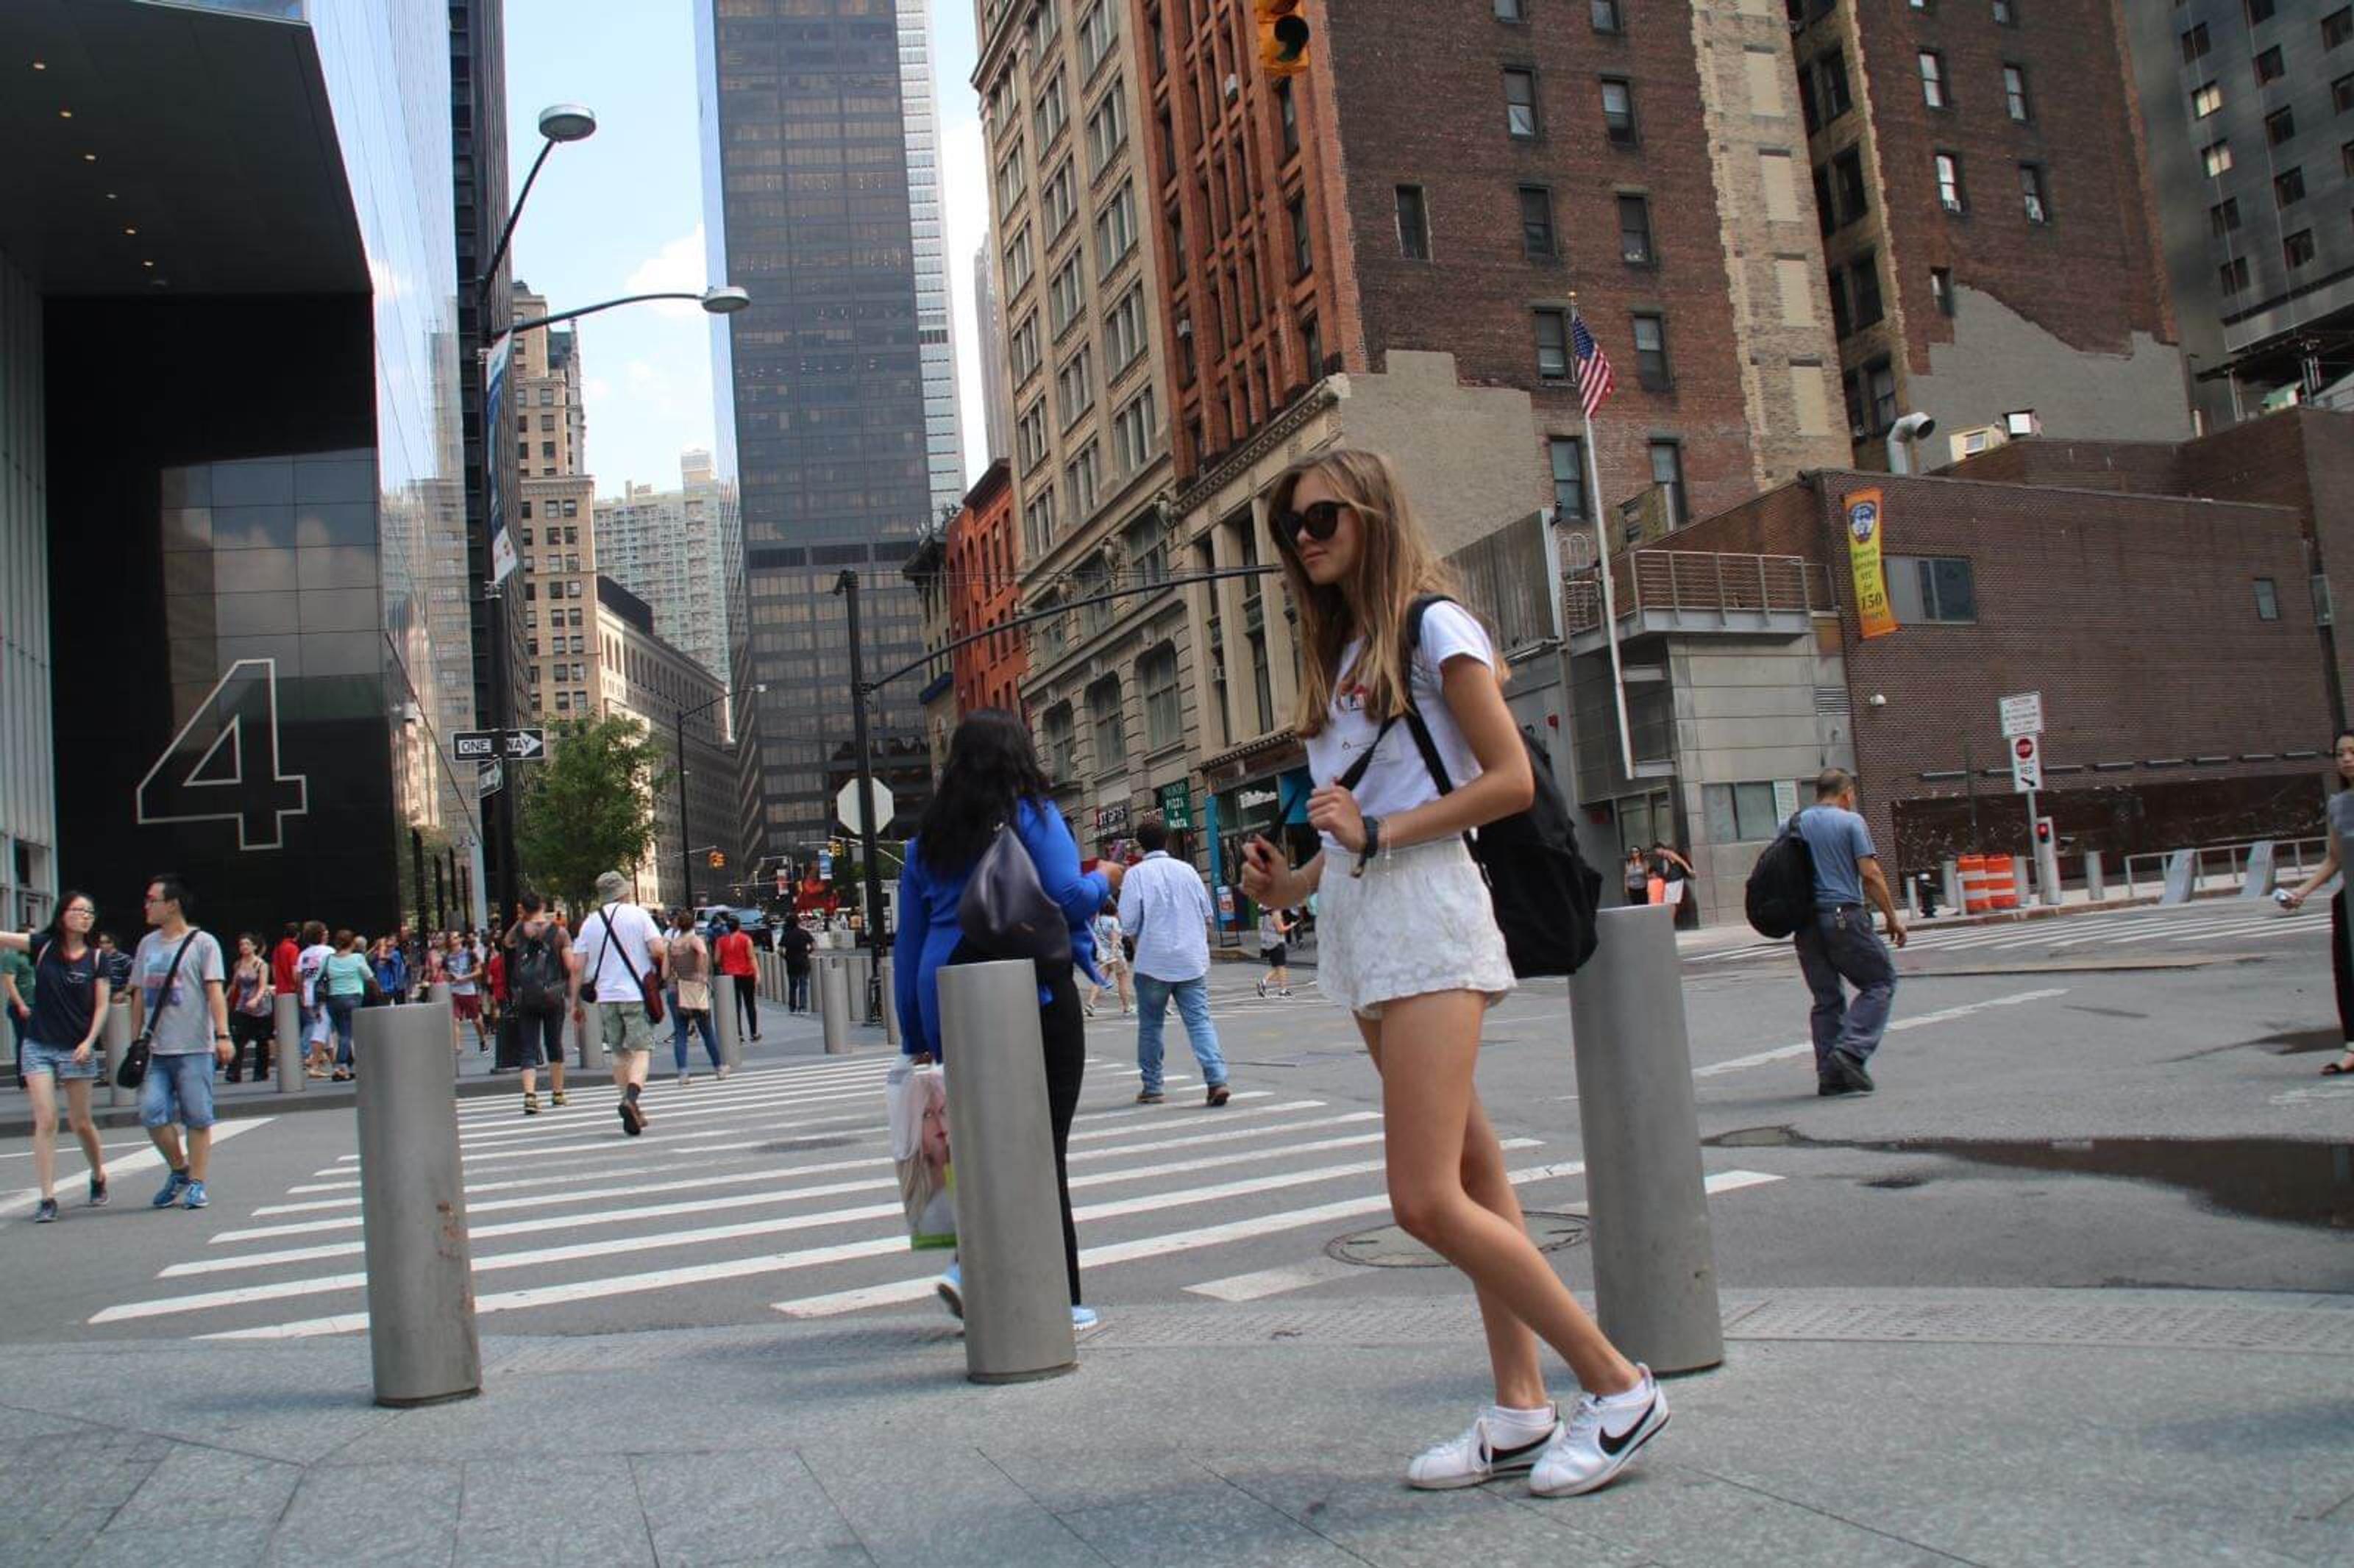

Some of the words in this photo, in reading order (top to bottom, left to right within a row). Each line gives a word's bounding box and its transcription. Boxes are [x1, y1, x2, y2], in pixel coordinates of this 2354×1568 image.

[1861, 593, 1882, 610] 150
[135, 658, 307, 852] 4
[462, 741, 488, 752] ONE
